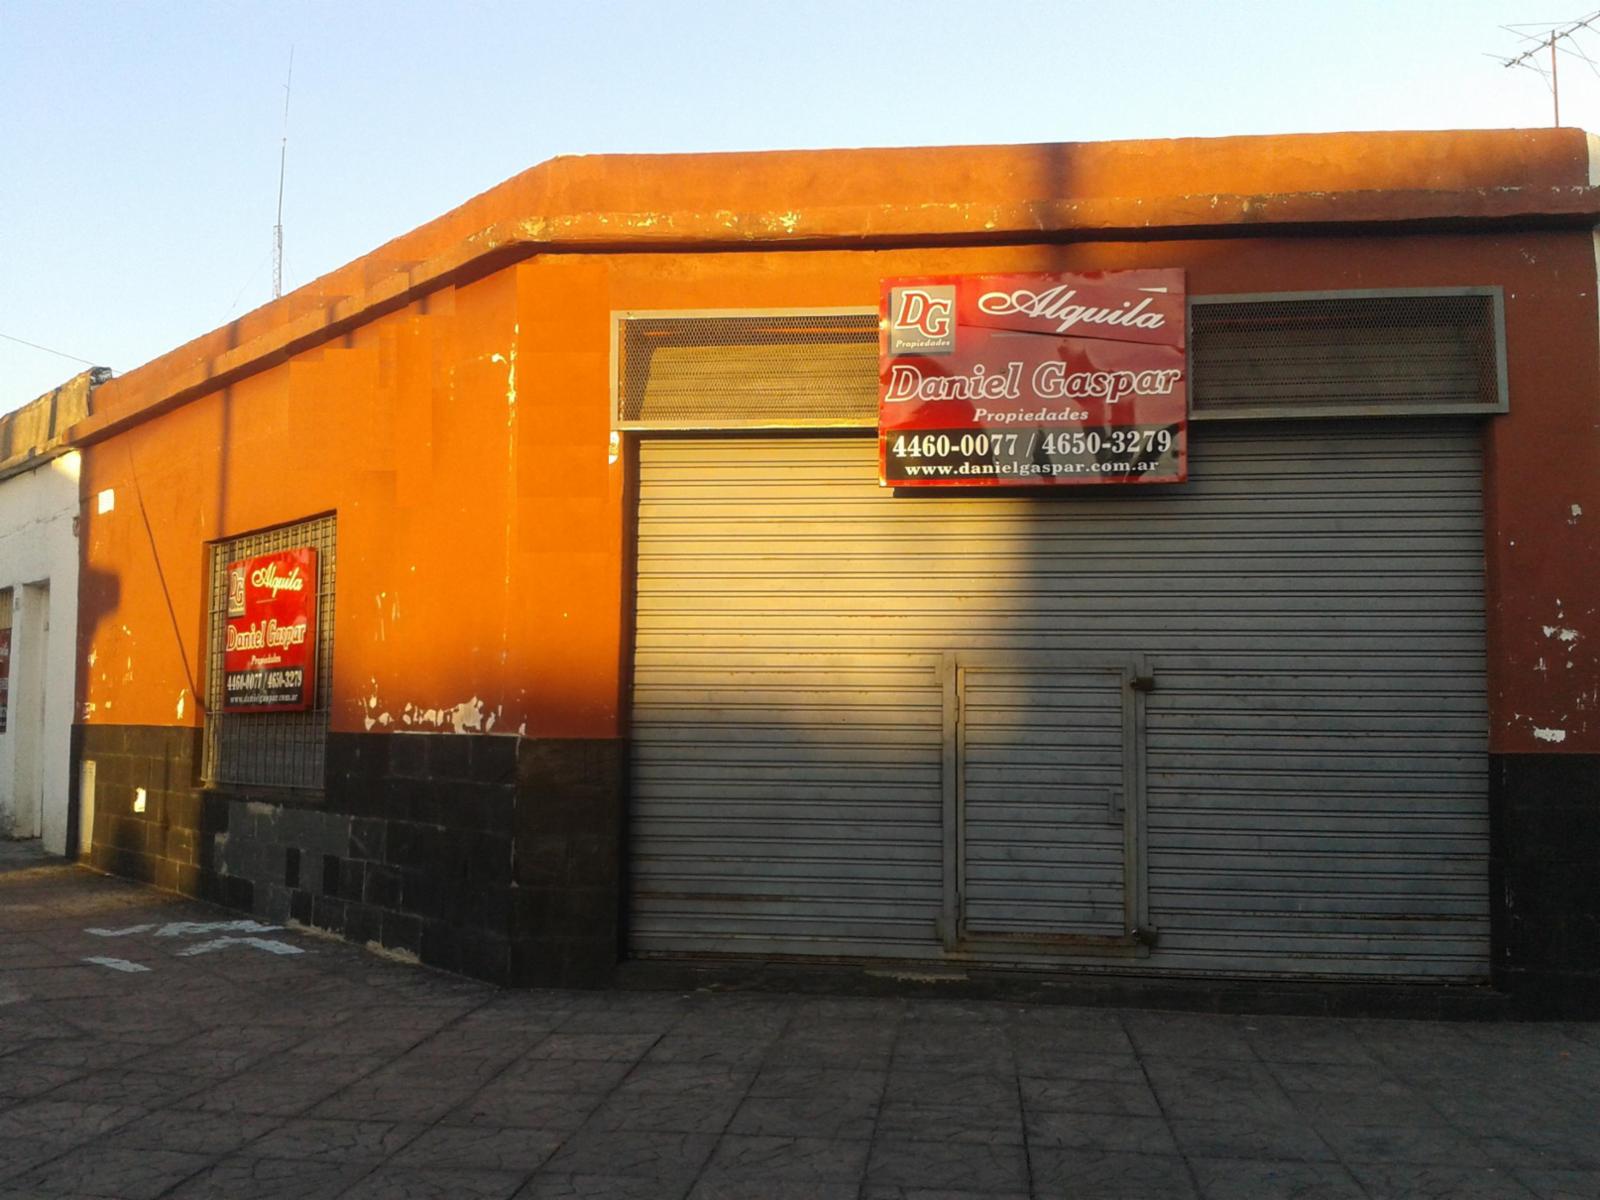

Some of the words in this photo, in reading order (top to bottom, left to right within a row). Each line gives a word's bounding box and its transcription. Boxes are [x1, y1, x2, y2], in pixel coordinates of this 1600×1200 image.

[896, 291, 951, 337] DG
[978, 284, 1165, 332] Alquila
[896, 339, 951, 349] Propiedades
[885, 362, 1024, 402] Daniel
[1033, 361, 1181, 403] Gaspar
[972, 408, 1089, 424] Propiedades
[892, 433, 1019, 458] 4460-0077
[1042, 430, 1172, 455] 4650-3279
[905, 460, 1159, 476] www.danielgaspar.com.ar
[252, 563, 303, 597] Alquila
[226, 620, 265, 652] Daniel
[267, 618, 307, 650] Gaspar
